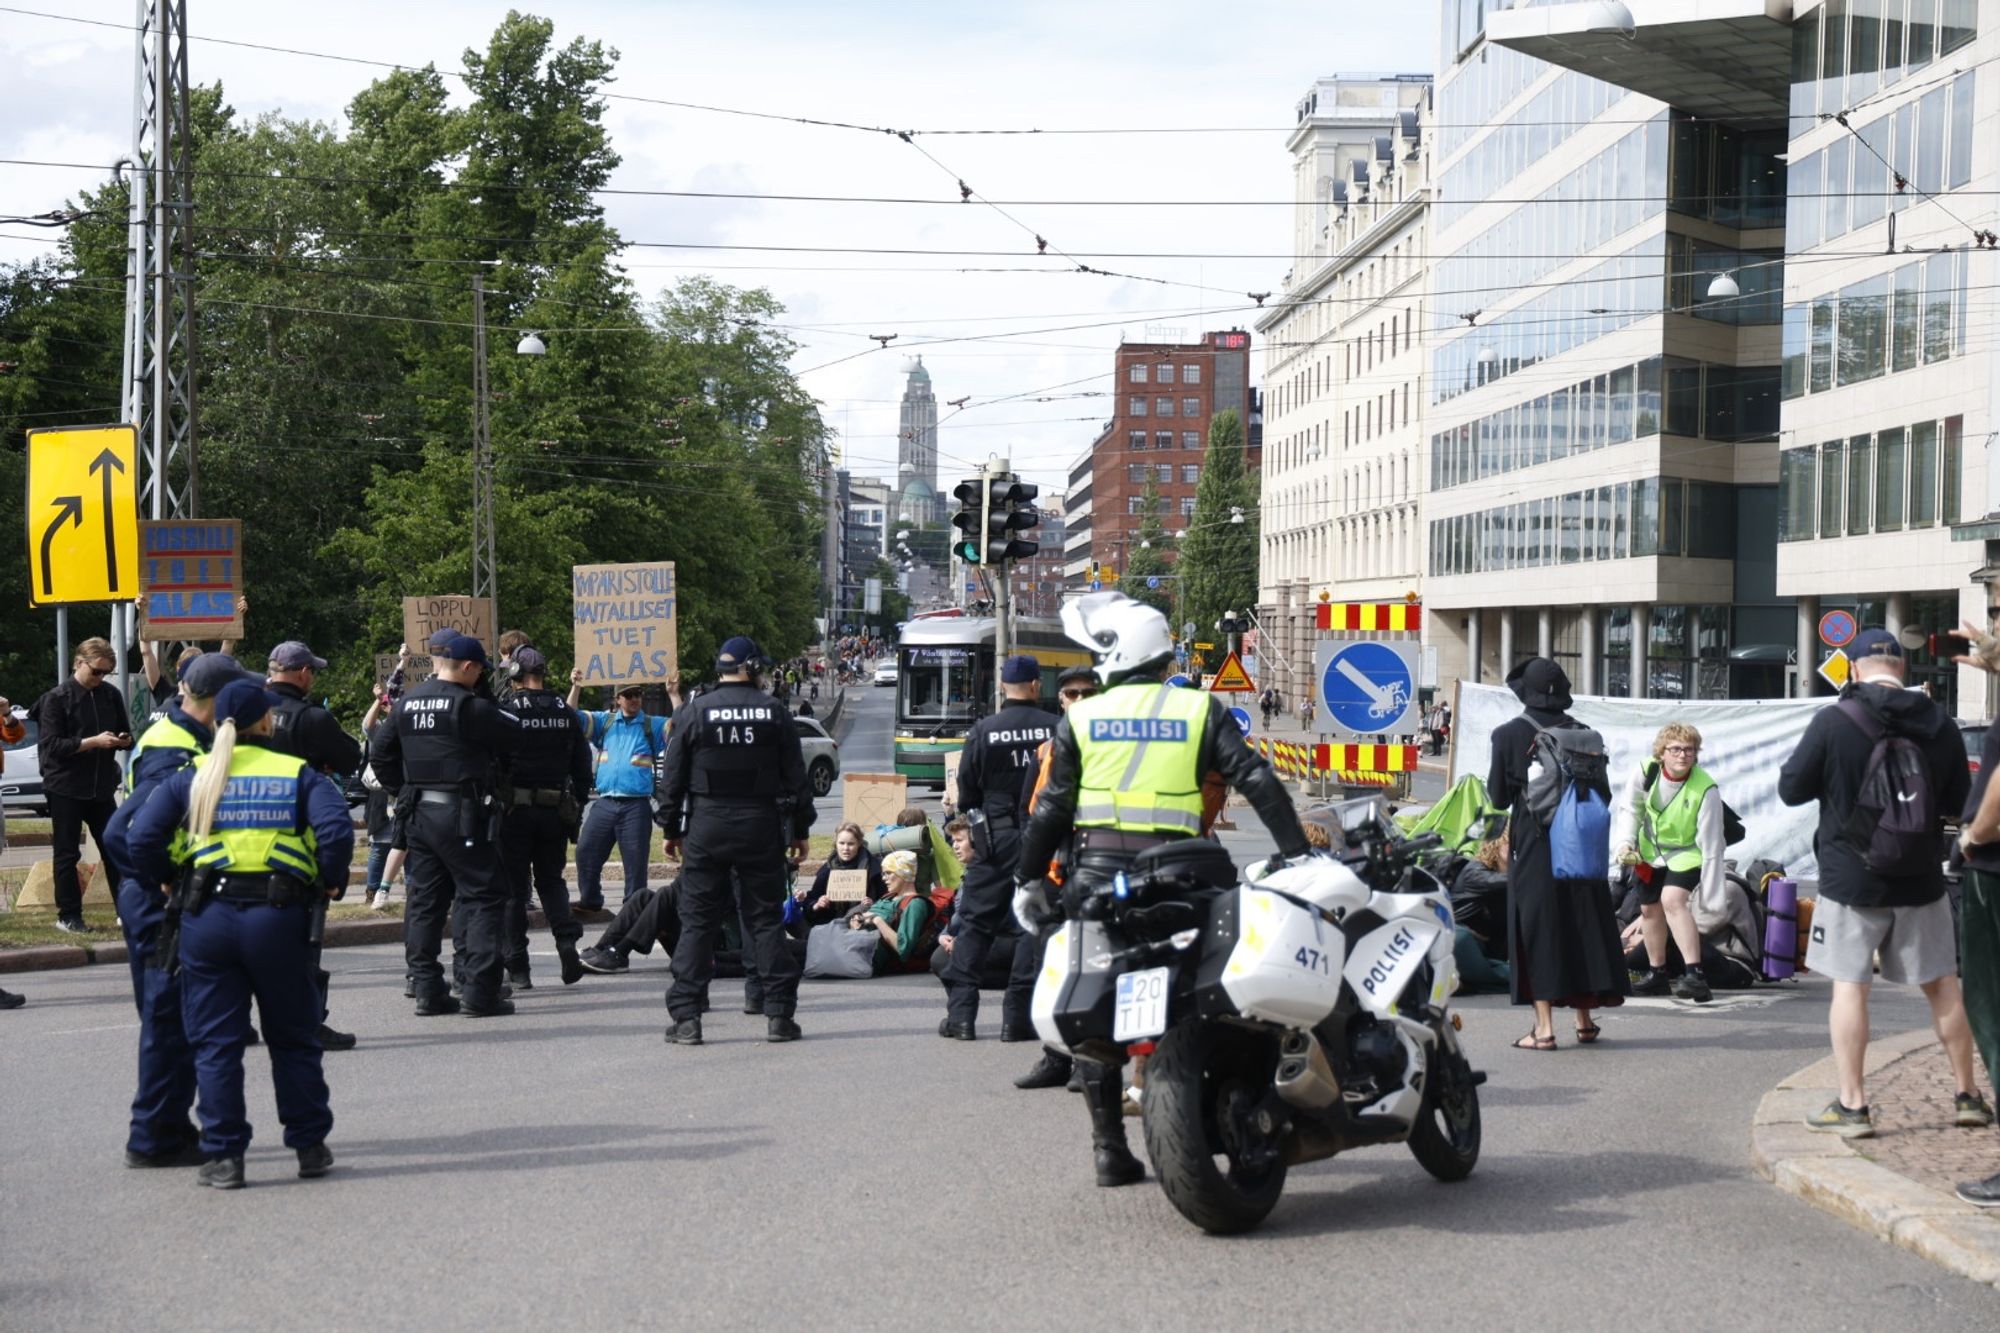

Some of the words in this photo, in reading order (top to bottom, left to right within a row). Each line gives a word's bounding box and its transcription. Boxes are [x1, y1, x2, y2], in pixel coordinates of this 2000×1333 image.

[148, 558, 232, 584] TUET
[149, 592, 233, 617] ALAS
[416, 600, 473, 617] LOPPU
[575, 598, 676, 624] HAITALLISET
[593, 626, 657, 647] TUET
[585, 650, 668, 680] ALAS
[909, 649, 919, 666] 7
[404, 699, 450, 712] POLIISI
[709, 708, 772, 721] POLIISI
[412, 713, 435, 730] 1A6
[522, 719, 570, 729] POLIISI
[1093, 721, 1183, 739] POLIISI
[716, 726, 755, 744] 1A5
[989, 728, 1051, 744] POLIISI
[1295, 946, 1329, 976] 471
[1362, 926, 1415, 995] POLIISI
[1136, 976, 1161, 1002] 20
